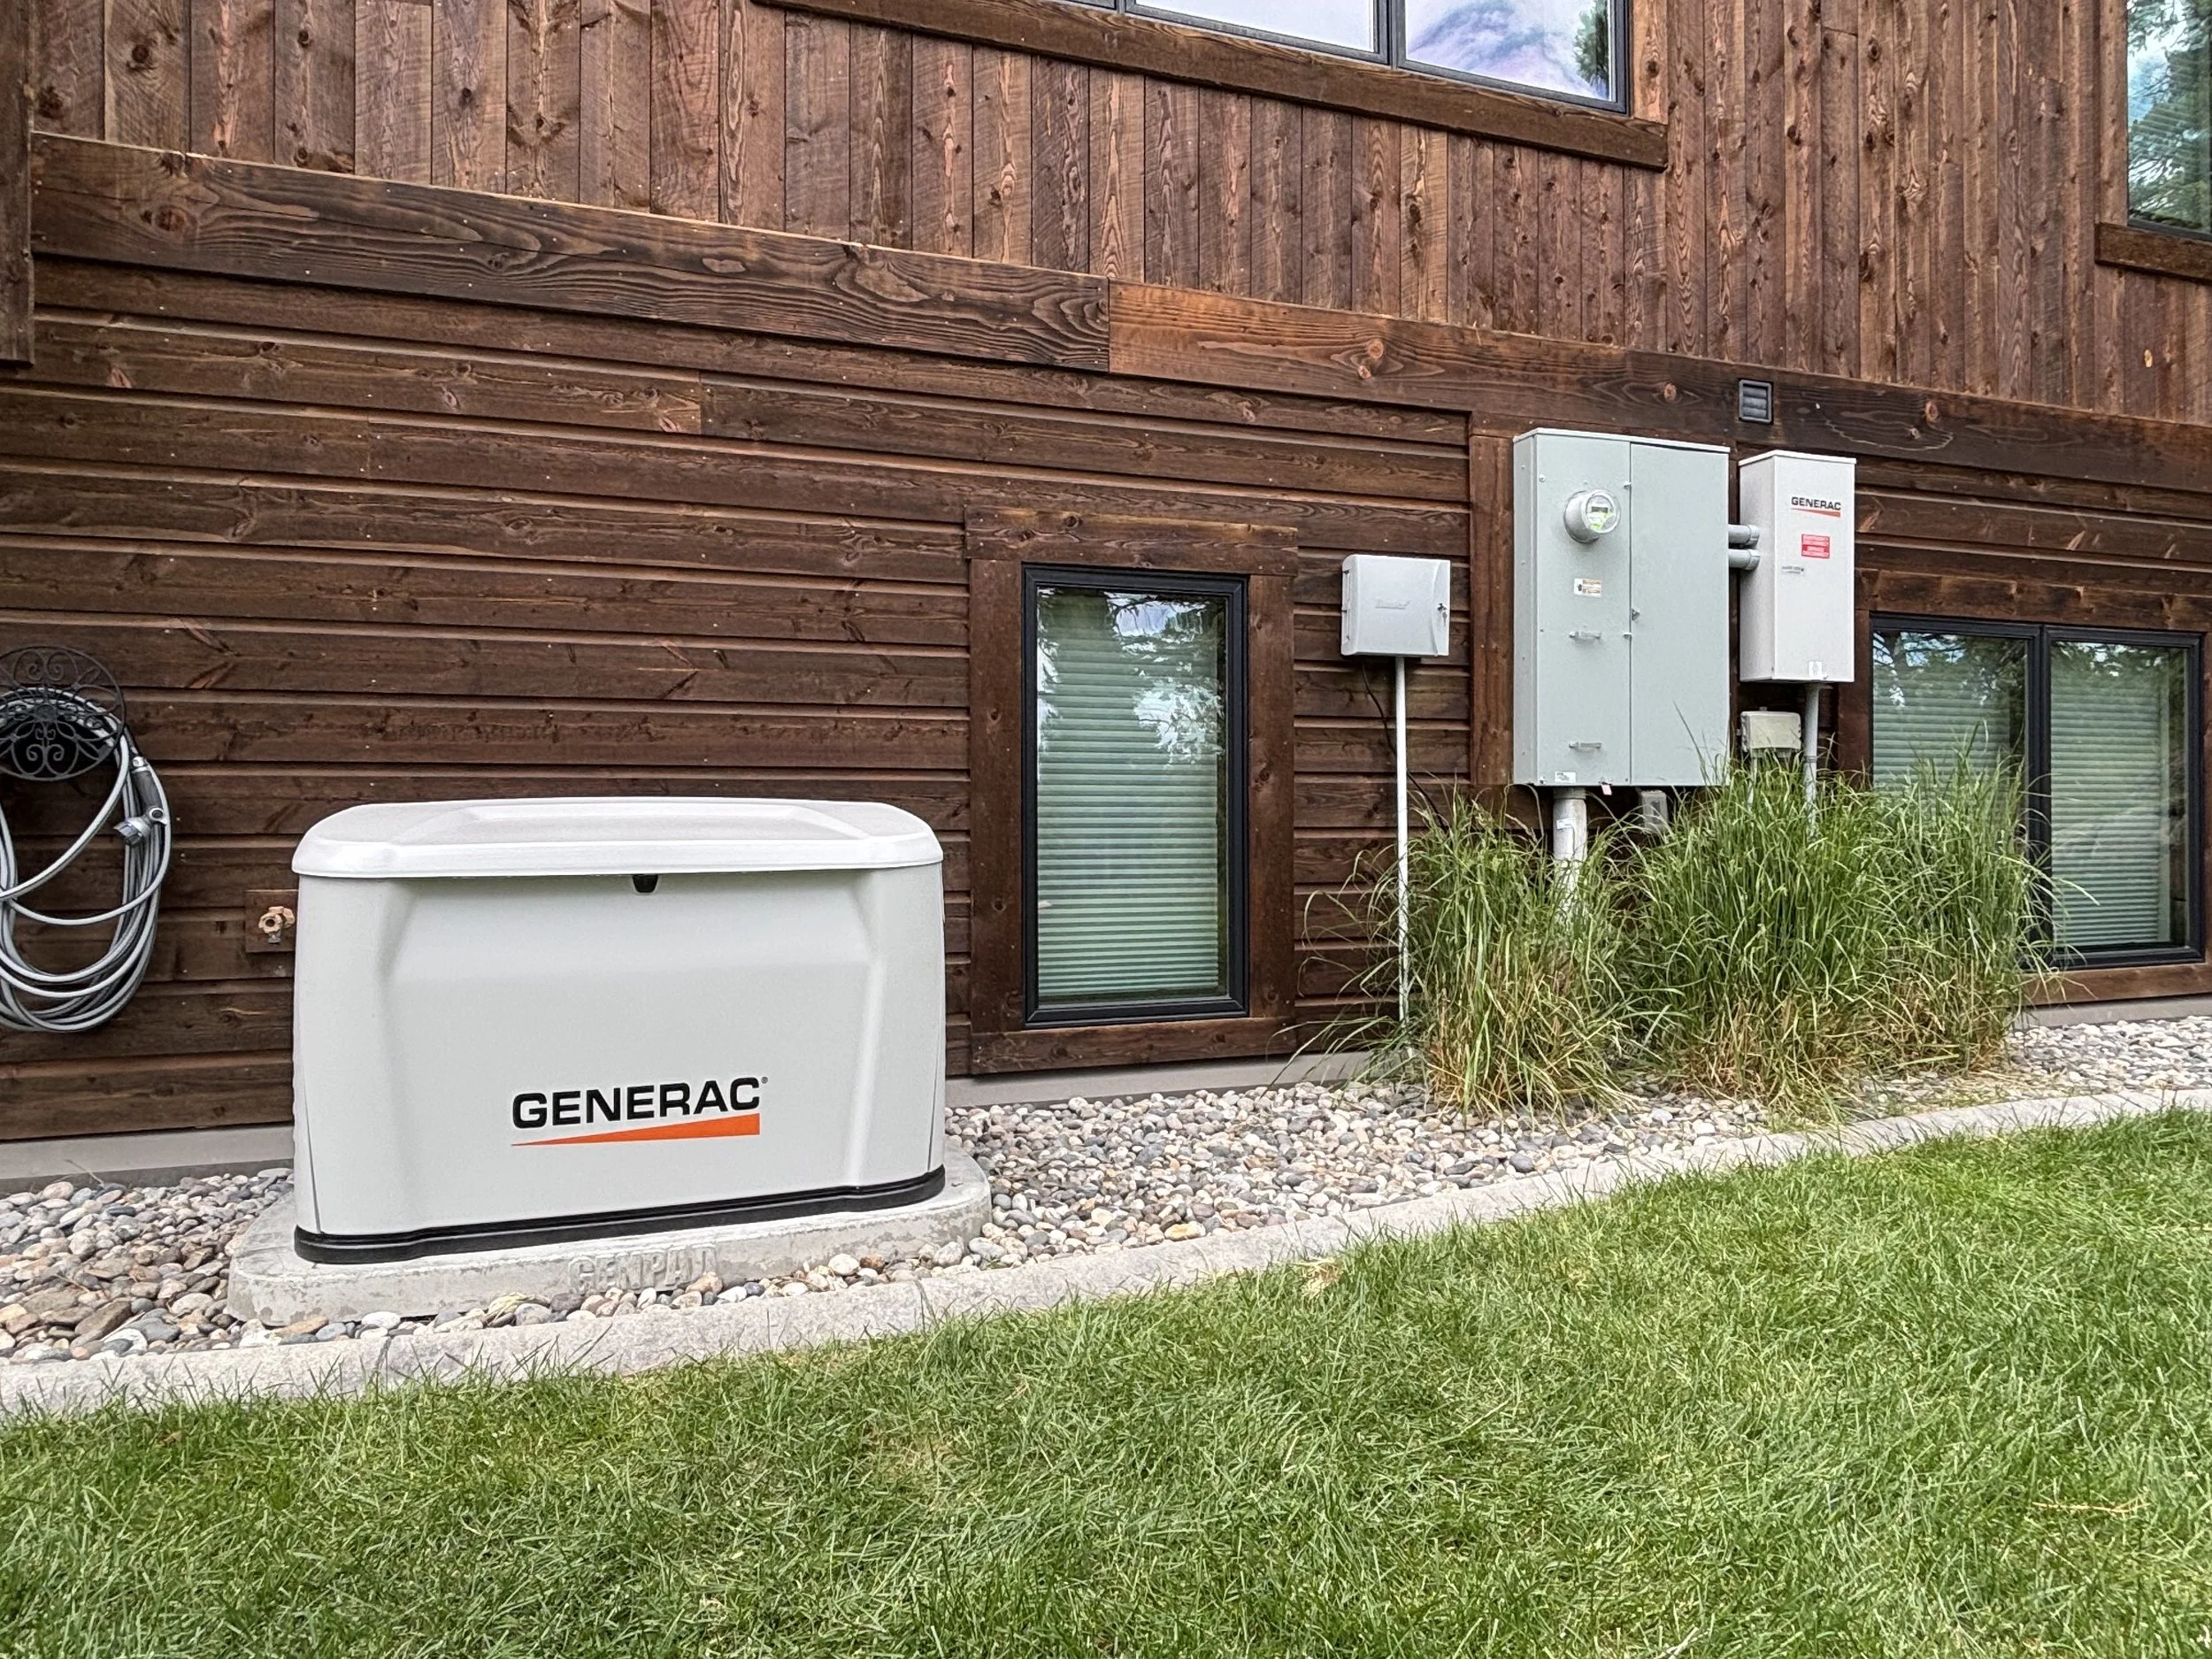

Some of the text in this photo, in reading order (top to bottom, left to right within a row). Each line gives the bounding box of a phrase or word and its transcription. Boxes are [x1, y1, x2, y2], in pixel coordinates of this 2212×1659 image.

[1791, 496, 1841, 511] GENERAC
[512, 1077, 760, 1129] GENERAC
[568, 1243, 719, 1295] GENPAD
